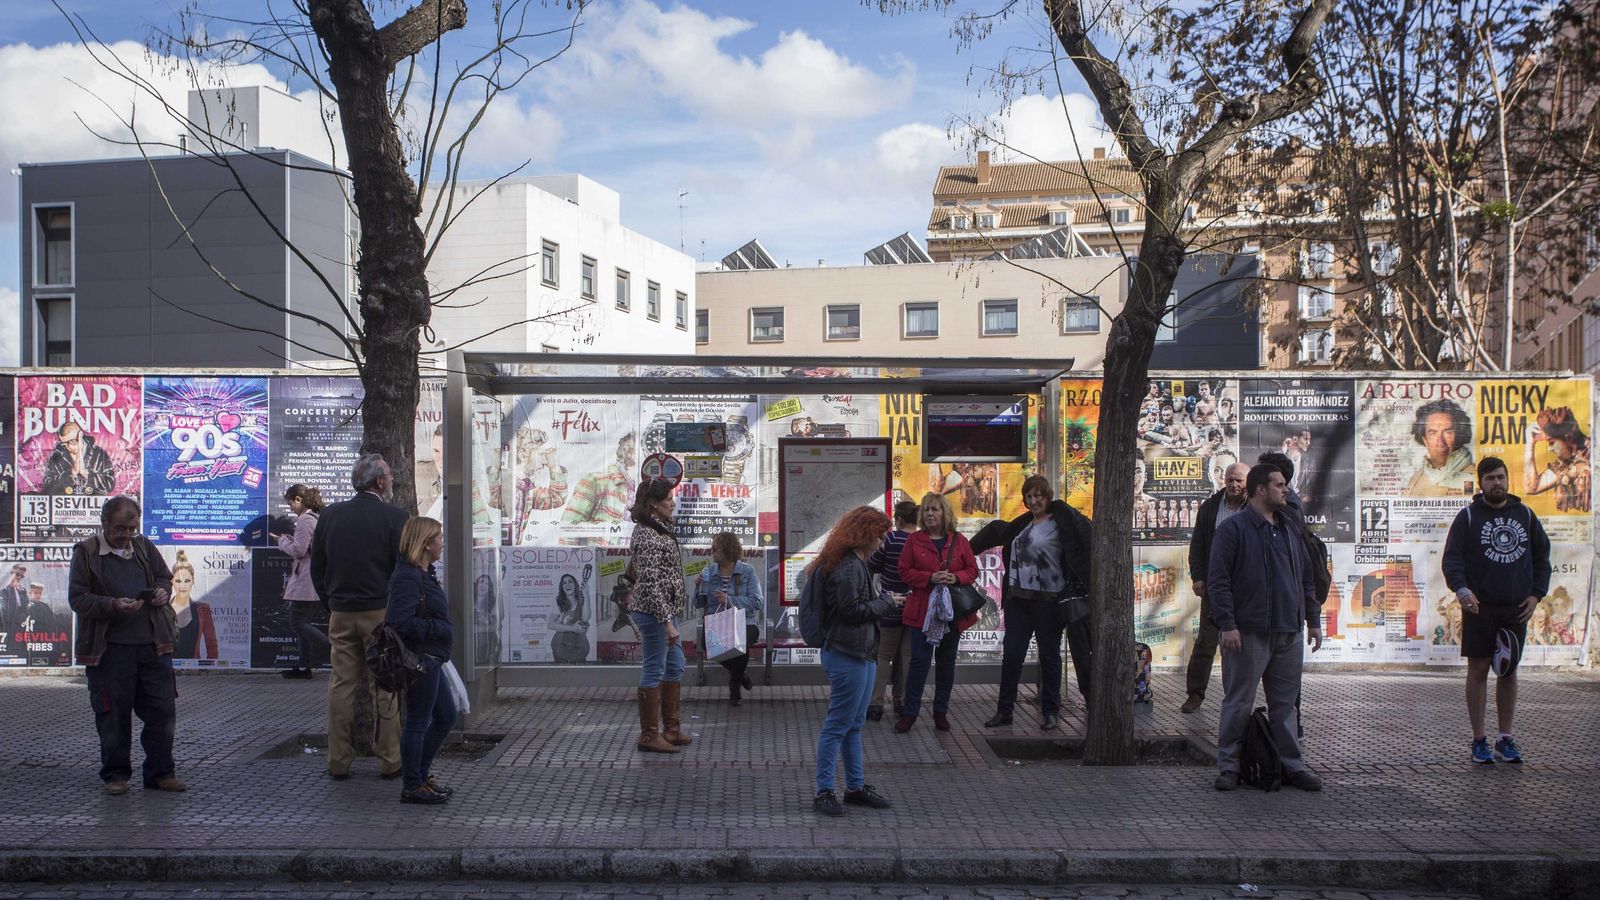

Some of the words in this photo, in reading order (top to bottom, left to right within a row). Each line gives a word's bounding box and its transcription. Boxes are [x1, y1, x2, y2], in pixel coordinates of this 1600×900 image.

[47, 383, 116, 407] BAD
[1361, 382, 1473, 400] ARTURO
[885, 394, 922, 415] NIC
[1244, 396, 1293, 407] ALEJANDRO
[1296, 394, 1349, 407] FERNÁNDEZ
[1481, 385, 1550, 414] NICKY
[23, 407, 139, 445] BUNNY
[172, 417, 200, 428] LOVE
[552, 408, 601, 440] #Félix
[1480, 416, 1527, 445] JAM
[171, 424, 243, 462] 90s
[1158, 461, 1186, 476] MAY
[1187, 461, 1198, 476] 5
[246, 471, 260, 482] 26
[710, 484, 751, 498] VENTA
[29, 502, 47, 516] 13
[1303, 515, 1327, 523] ROLA
[1362, 507, 1388, 530] 12
[744, 527, 754, 535] 65
[1481, 521, 1494, 545] PICOS
[1494, 517, 1505, 526] DE
[0, 547, 34, 561] DEXE
[212, 551, 244, 559] PASTORA
[512, 549, 594, 564] SOLEDAD
[1355, 546, 1386, 554] Festival
[1484, 545, 1526, 564] CANTABRIA
[203, 555, 245, 569] SOLER
[1355, 555, 1394, 563] Orbitando
[1552, 564, 1577, 573] ASH
[1144, 583, 1176, 599] MAYO
[210, 607, 249, 615] SEVILLA
[15, 632, 67, 642] SEVILLA
[960, 632, 998, 640] SEVILLA
[1142, 628, 1164, 638] DANNY
[27, 643, 53, 652] FIBES
